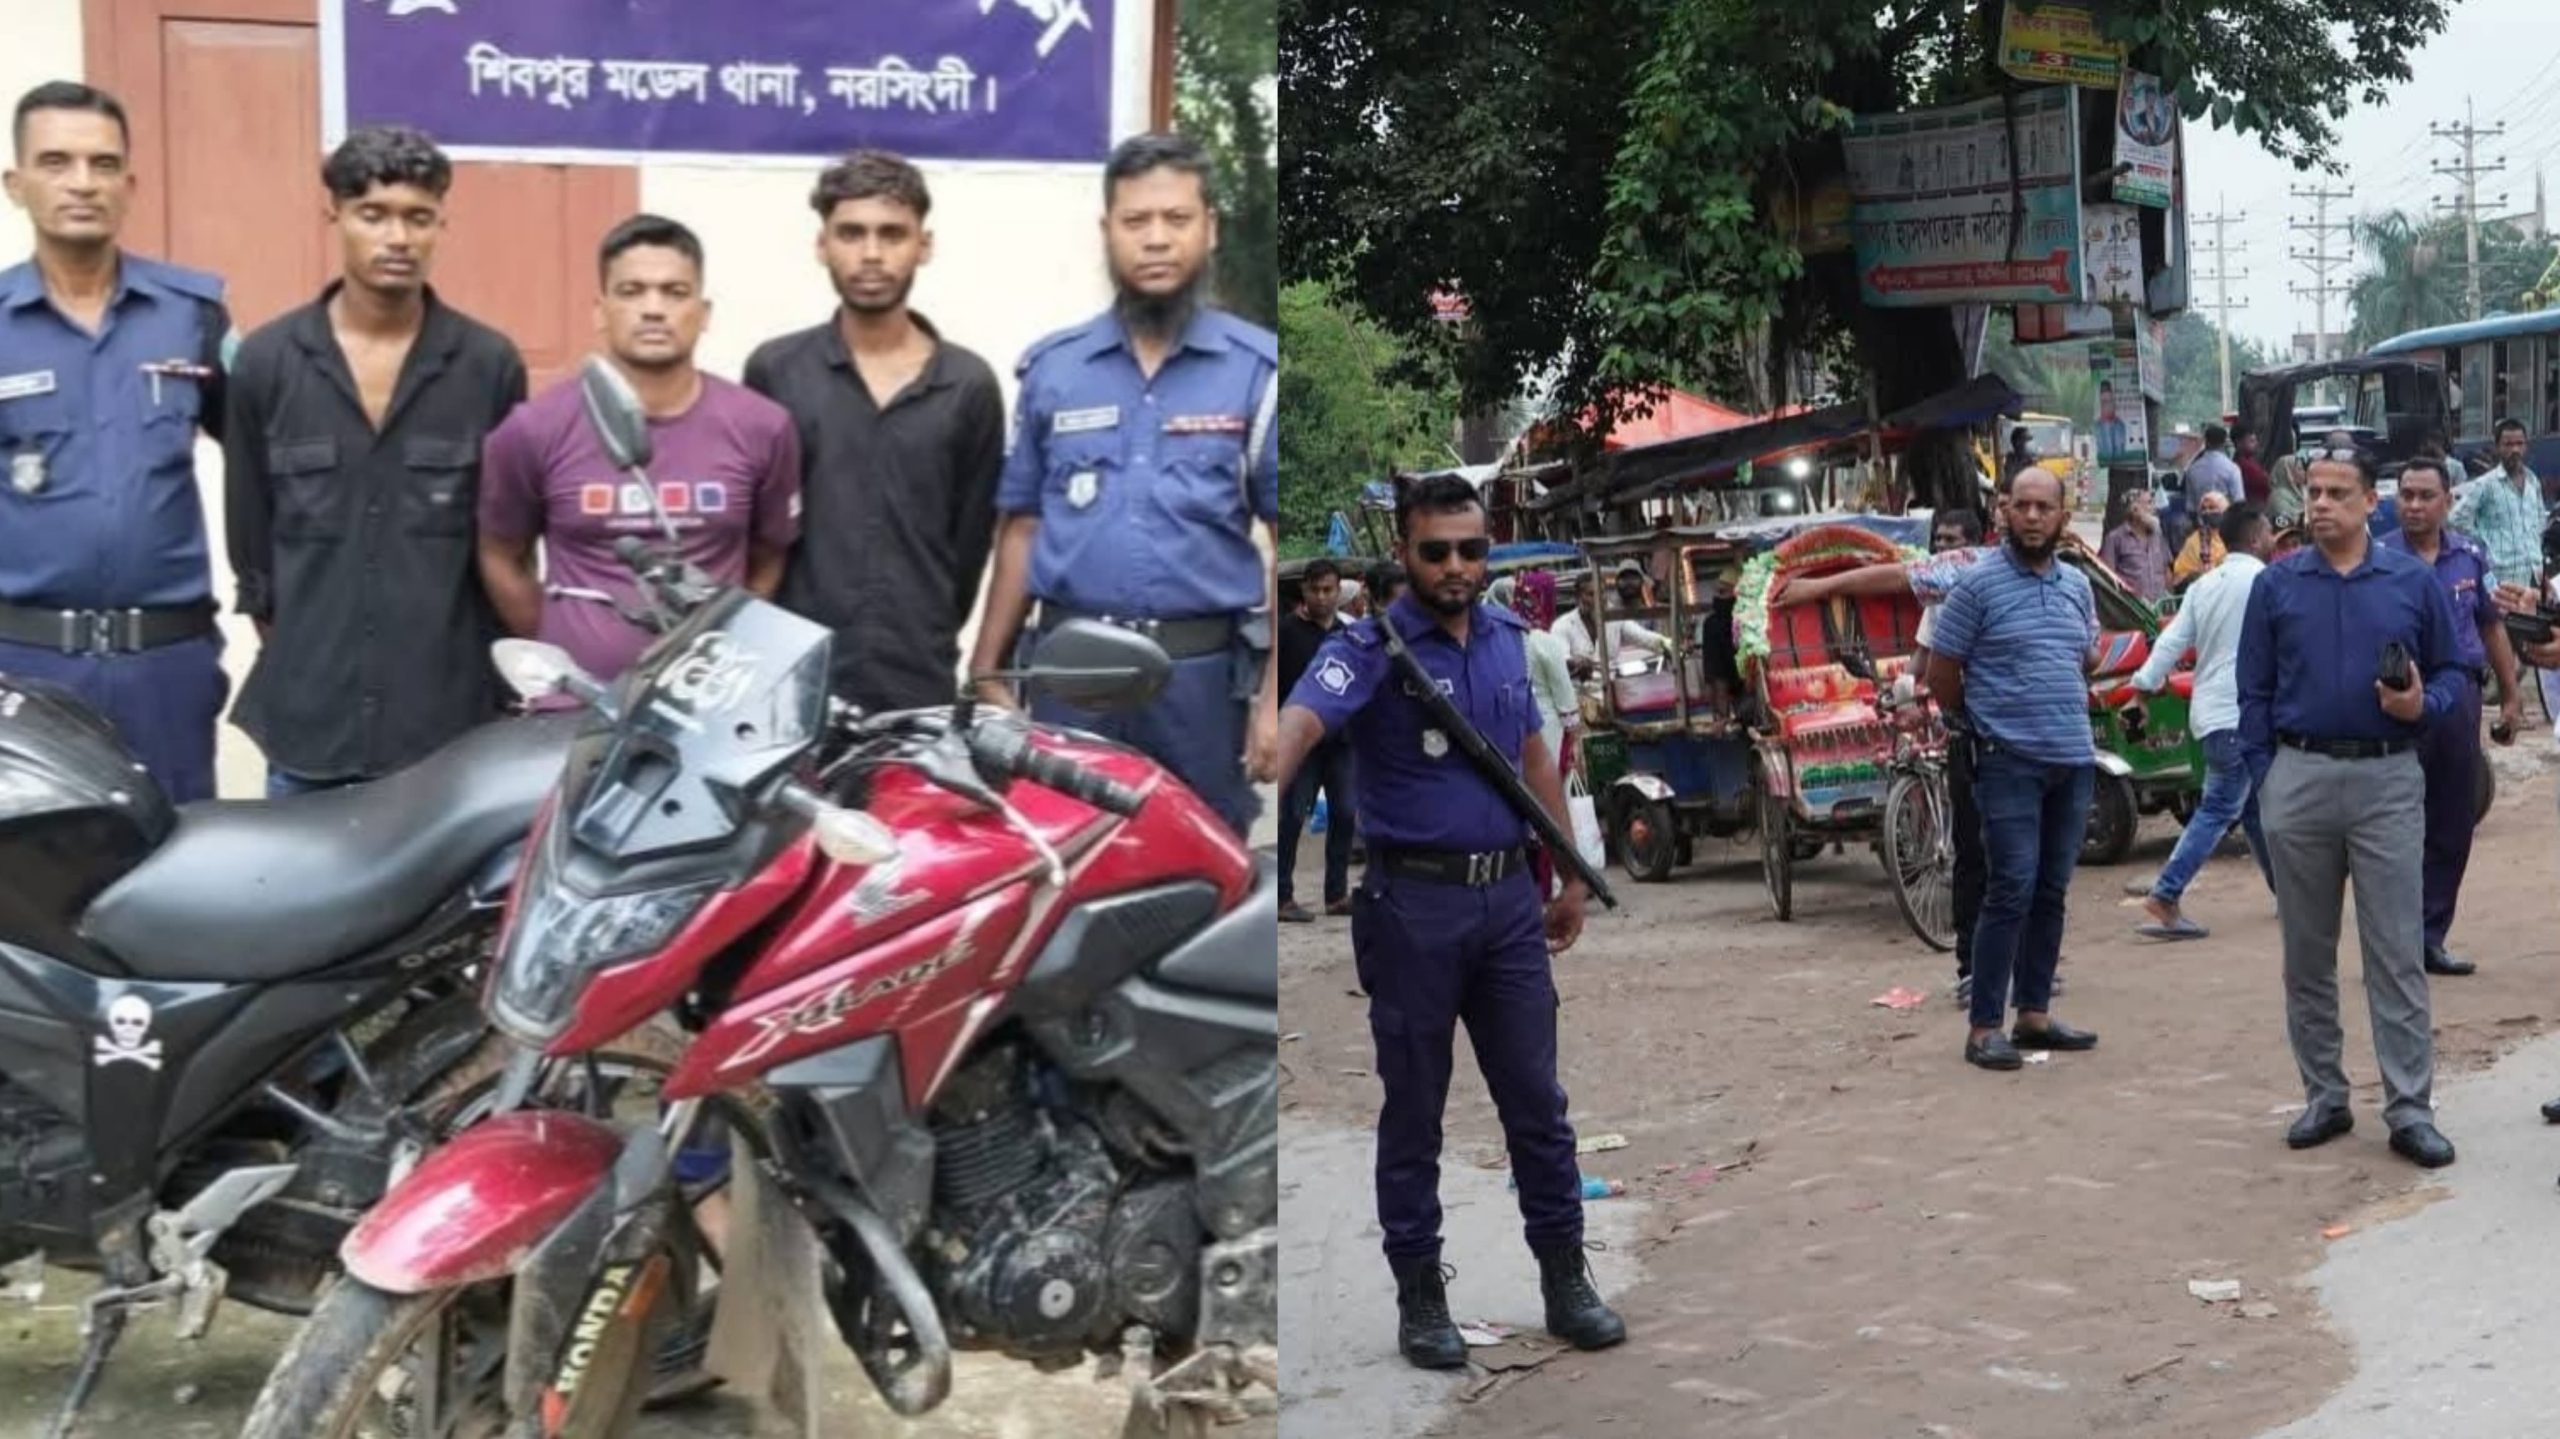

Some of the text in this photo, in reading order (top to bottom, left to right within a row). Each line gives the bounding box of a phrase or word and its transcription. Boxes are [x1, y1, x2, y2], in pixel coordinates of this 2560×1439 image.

[464, 42, 594, 110] শিবপুর
[599, 59, 711, 105] মডেল
[554, 1266, 633, 1393] HONDA
